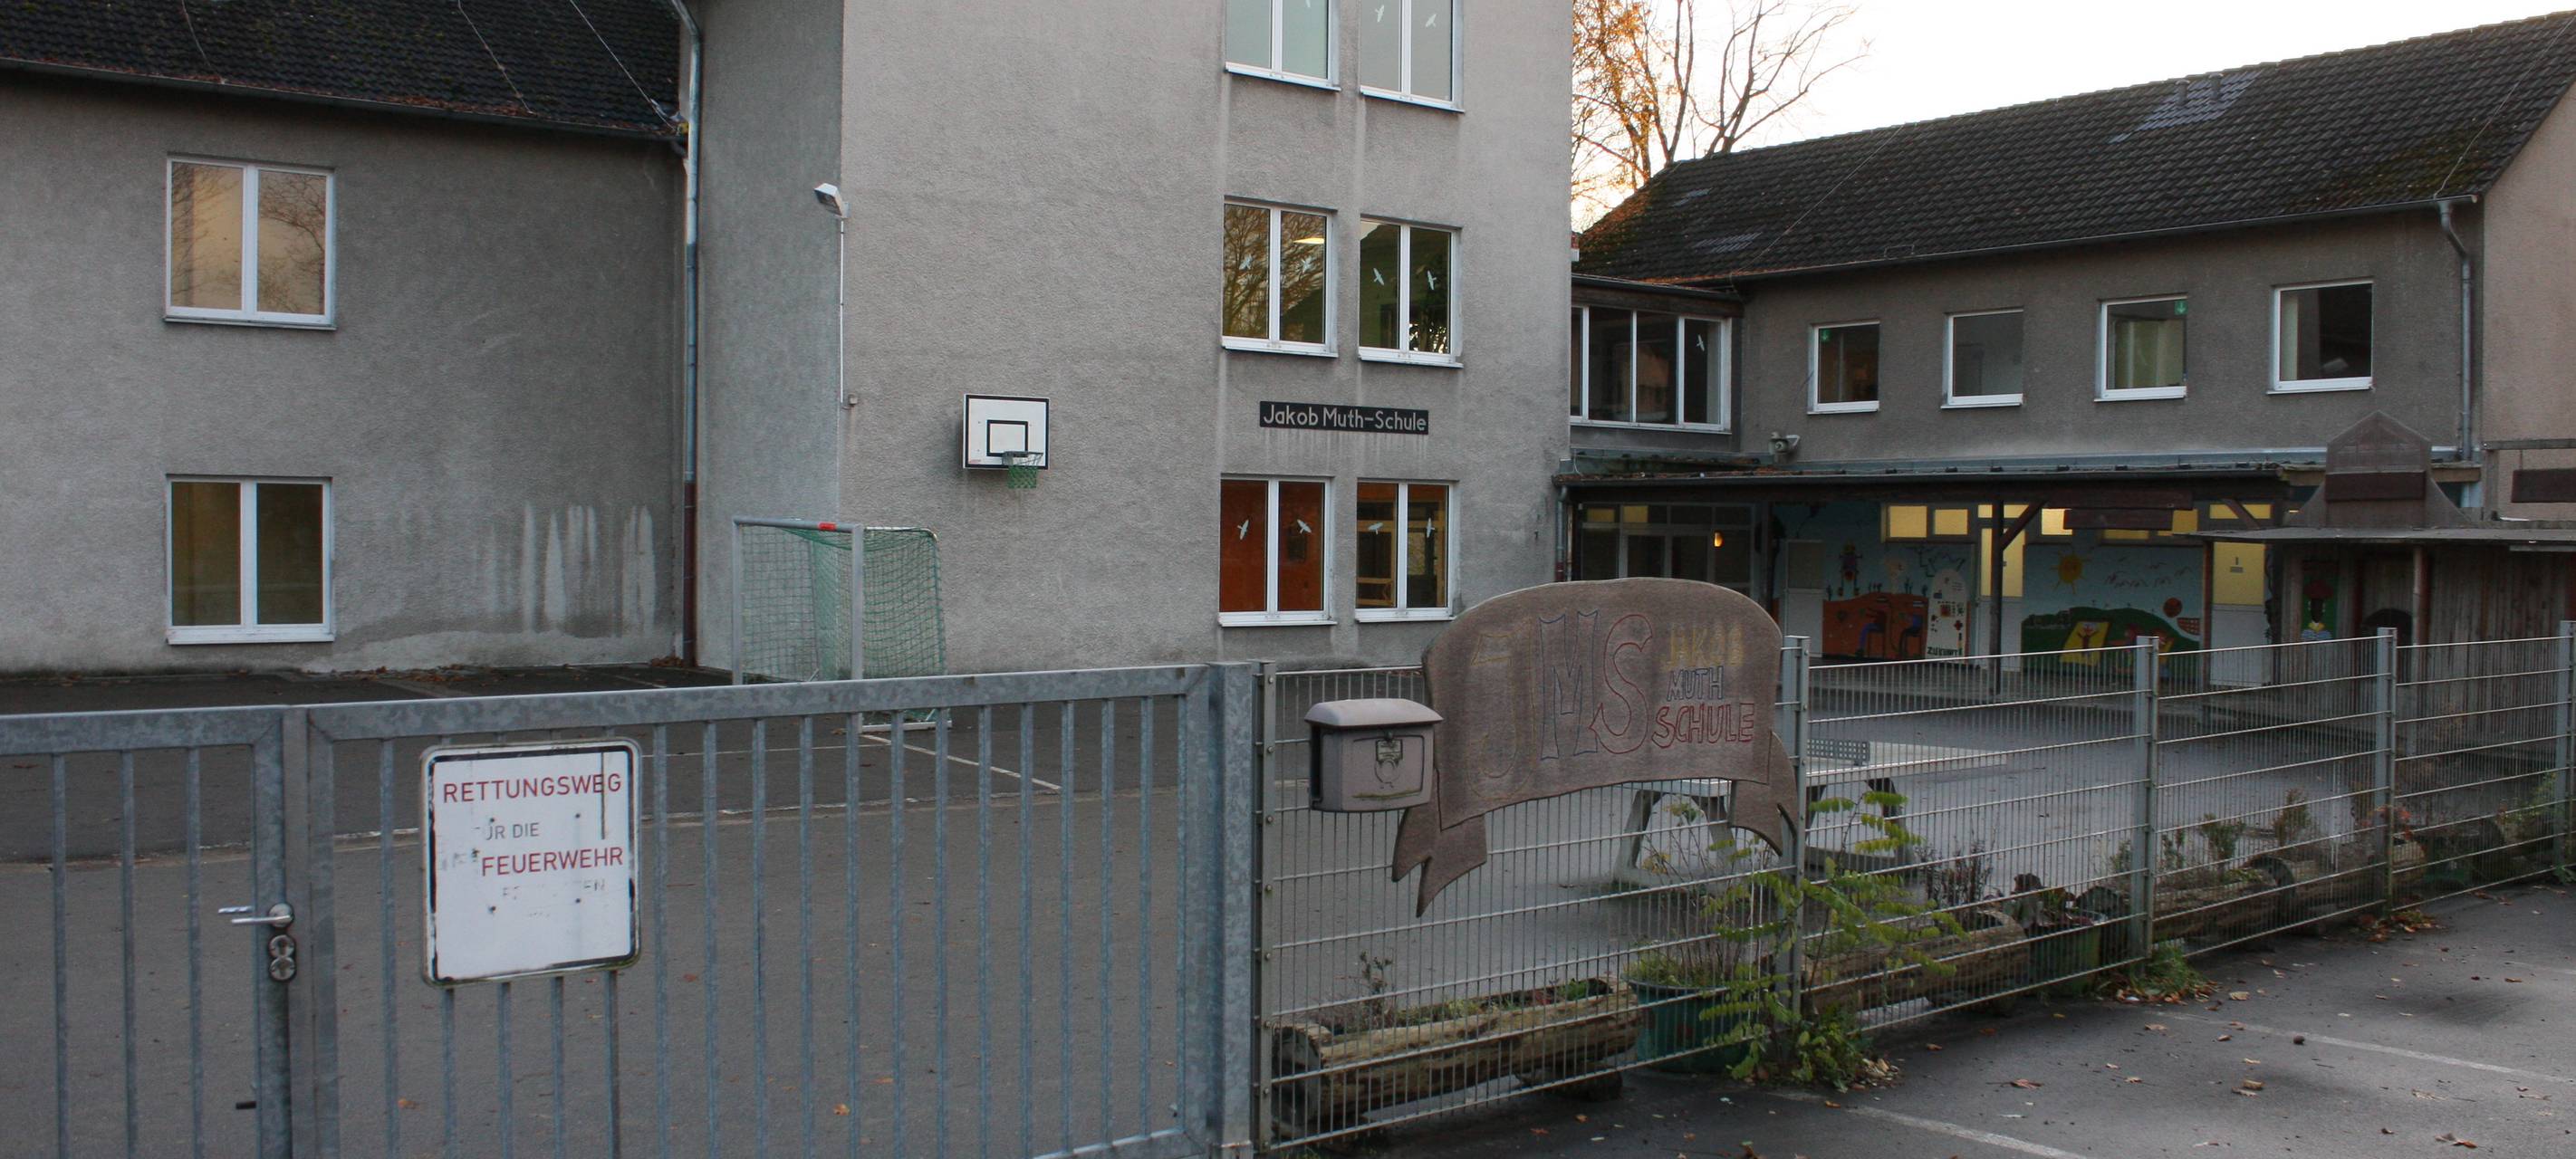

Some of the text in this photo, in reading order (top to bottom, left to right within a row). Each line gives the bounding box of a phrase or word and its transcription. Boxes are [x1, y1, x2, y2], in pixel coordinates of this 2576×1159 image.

[1264, 405, 1427, 431] Jakob Muth-Schule
[1666, 666, 1725, 702] MUTH
[1650, 702, 1755, 750] SCHULE
[443, 773, 622, 803] RETTUNGSWEG
[513, 822, 540, 838] DIE
[482, 847, 624, 876] FEUERWEHR
